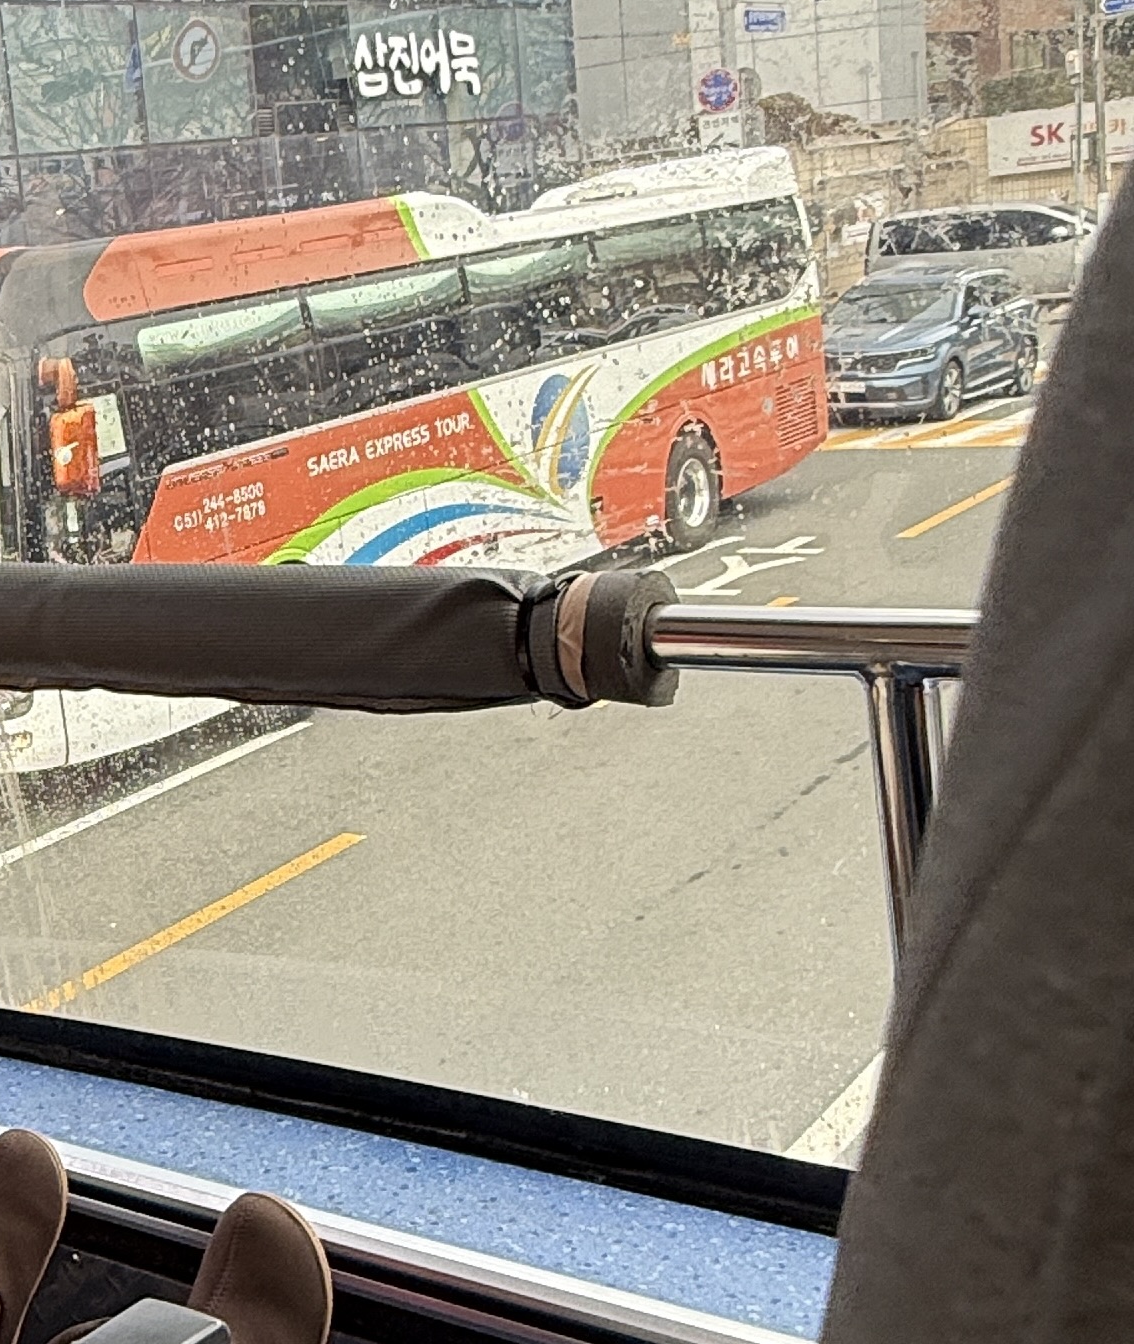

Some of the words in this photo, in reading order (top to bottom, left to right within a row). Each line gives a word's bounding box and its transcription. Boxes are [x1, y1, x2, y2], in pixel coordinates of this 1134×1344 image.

[355, 29, 481, 97] 삼진어묵
[1030, 122, 1065, 147] SK
[306, 446, 361, 477] SAERA
[365, 424, 430, 459] EXPRESS
[203, 482, 264, 513] 244-8500
